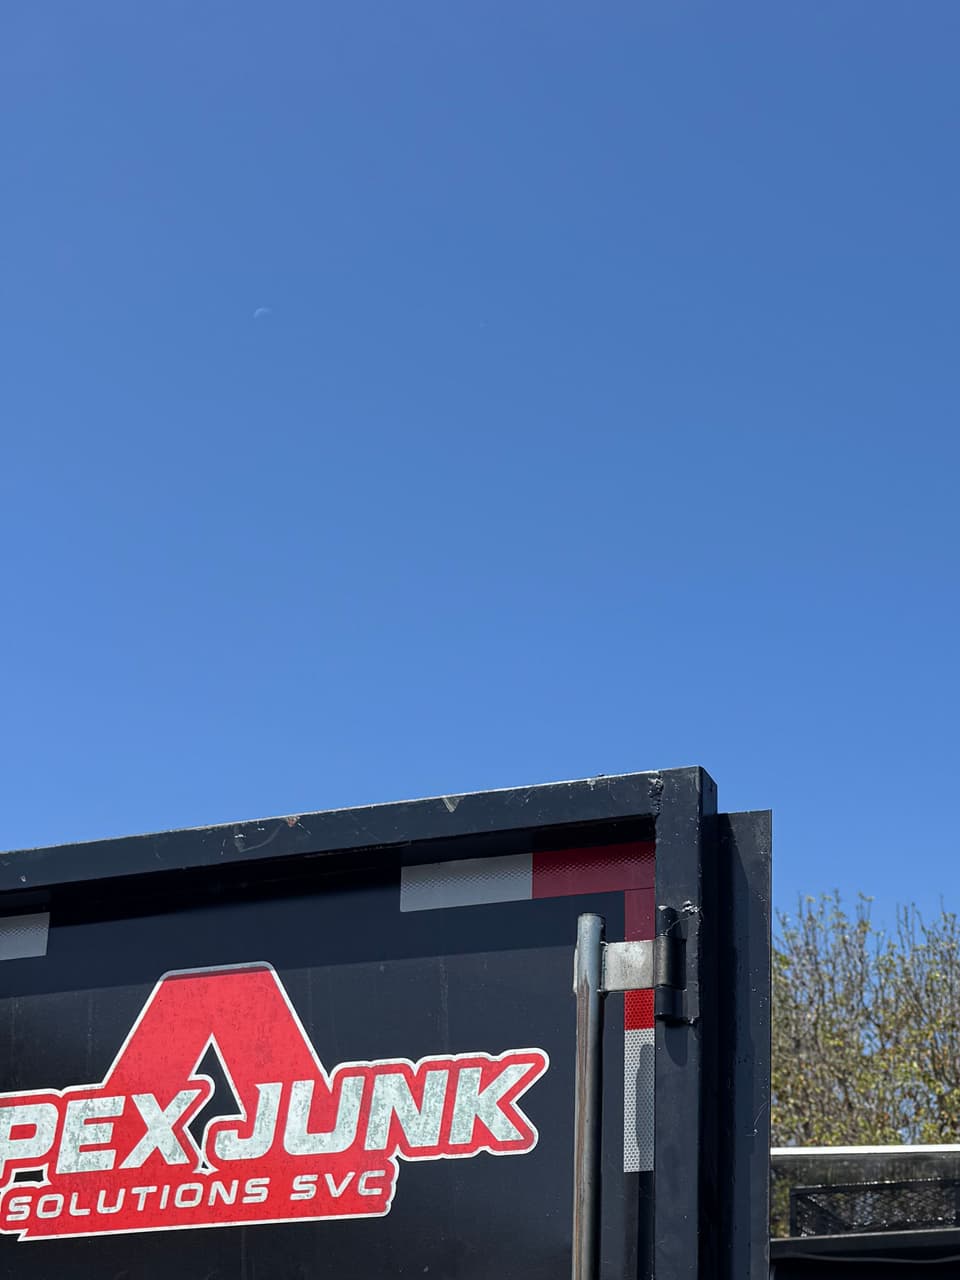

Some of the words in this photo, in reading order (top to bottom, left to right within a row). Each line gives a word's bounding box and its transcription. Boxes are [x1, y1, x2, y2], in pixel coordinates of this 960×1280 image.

[0, 1089, 201, 1178] PEX
[214, 1062, 538, 1161] JUNK
[6, 1178, 270, 1221] SOLUTIONS
[290, 1170, 386, 1200] SVC
